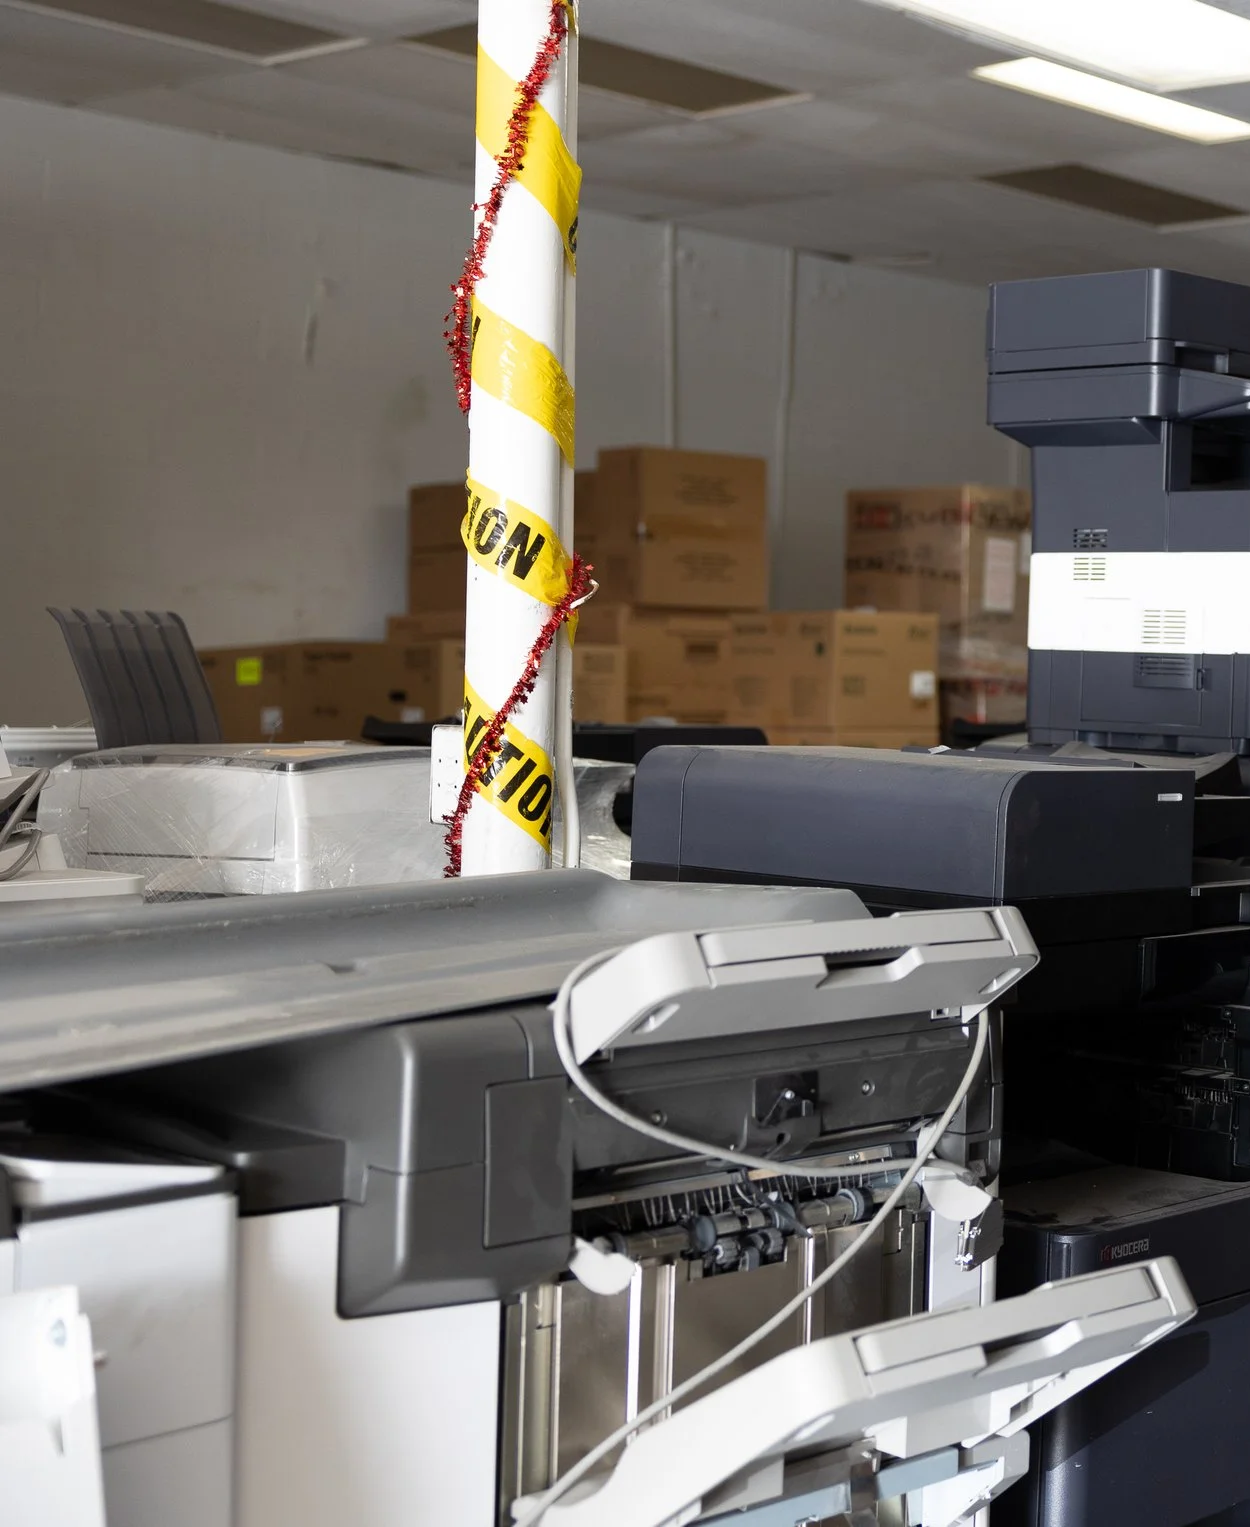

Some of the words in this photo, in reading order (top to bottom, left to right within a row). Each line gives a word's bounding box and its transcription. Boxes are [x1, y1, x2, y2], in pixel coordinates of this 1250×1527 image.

[465, 484, 546, 580] ION
[464, 696, 552, 837] UTIO
[1111, 1238, 1149, 1260] KYOCERA
